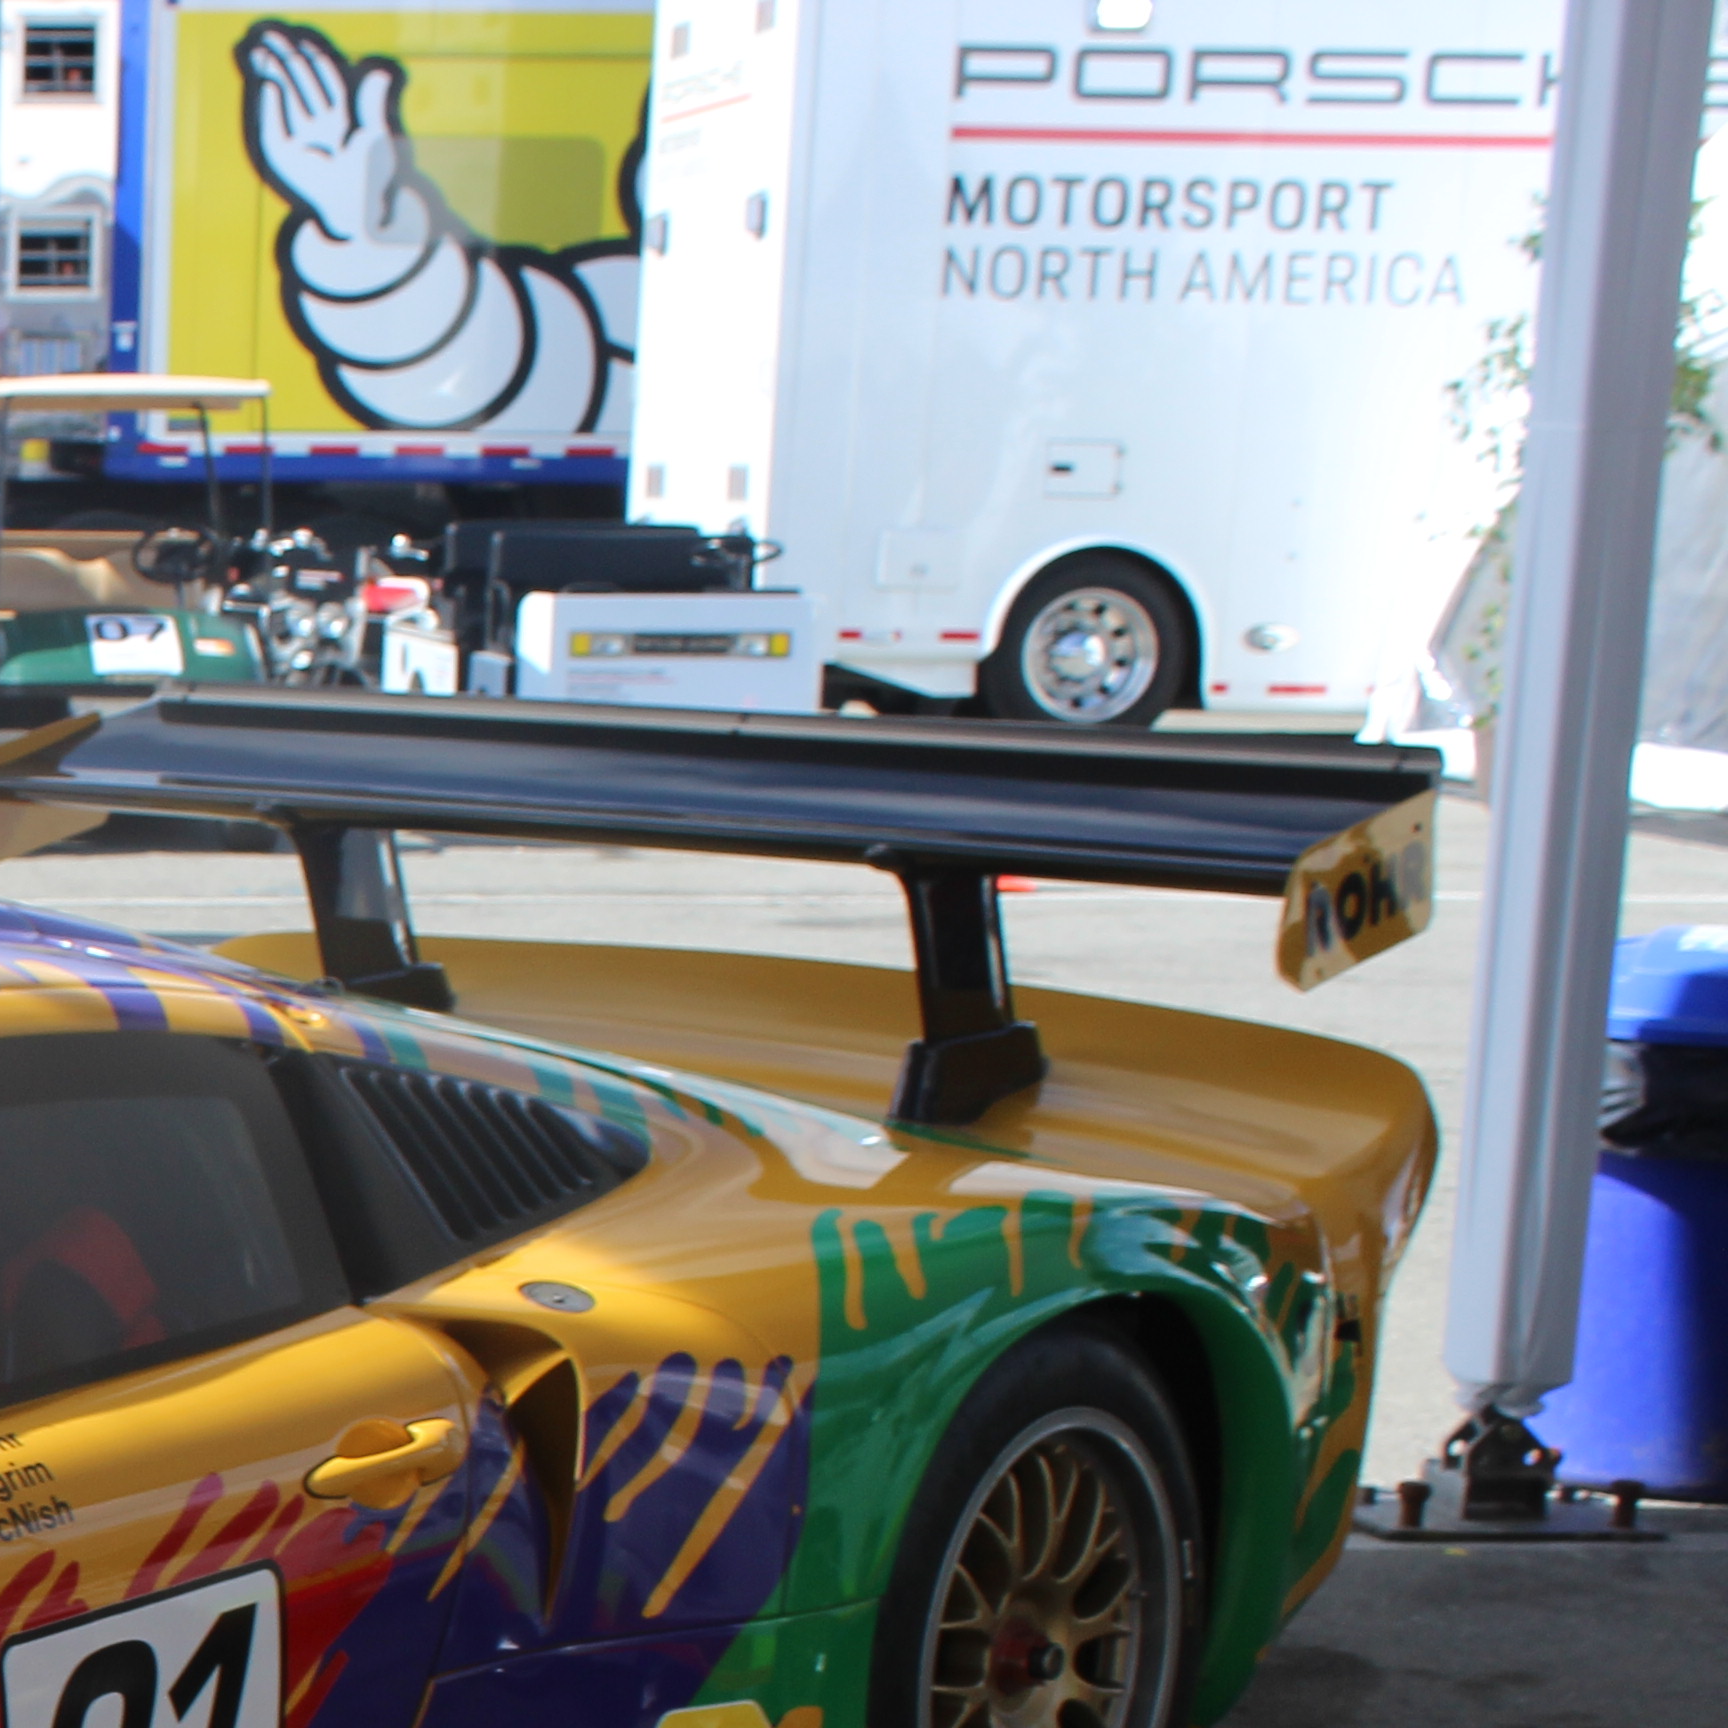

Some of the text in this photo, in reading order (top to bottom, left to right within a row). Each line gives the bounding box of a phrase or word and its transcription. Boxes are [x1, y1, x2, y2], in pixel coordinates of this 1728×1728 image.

[952, 44, 1728, 107] PORSC
[946, 174, 1395, 233] MOTORSPORT
[942, 244, 1467, 307] NORTH AMERICA
